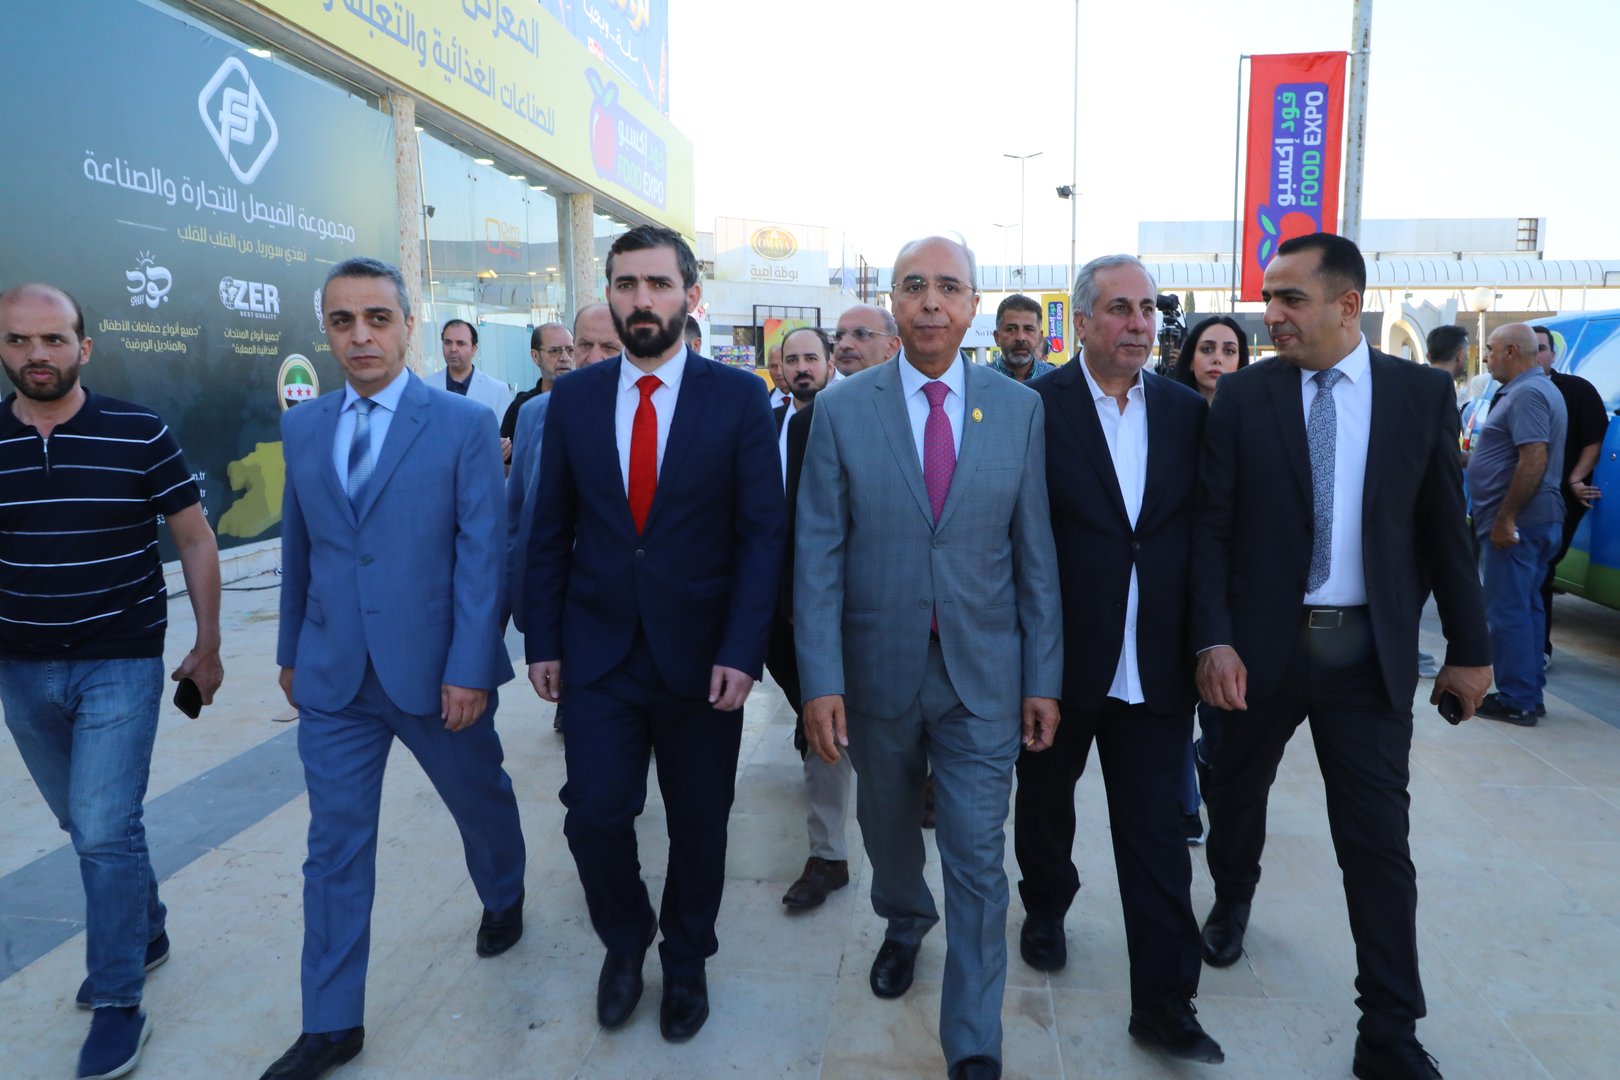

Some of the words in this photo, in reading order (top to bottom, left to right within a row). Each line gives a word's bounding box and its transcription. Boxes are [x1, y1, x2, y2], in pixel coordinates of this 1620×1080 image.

[341, 0, 427, 68] والتعب
[432, 28, 496, 100] الغذائية
[500, 82, 555, 136] للصناعات
[1277, 91, 1300, 132] فود
[1303, 91, 1324, 146] EXPO
[84, 150, 177, 206] والصناعة
[182, 176, 238, 216] للتجارة
[617, 154, 641, 191] FOOD
[643, 170, 664, 204] EXPO
[1300, 150, 1321, 207] FOOD
[242, 193, 295, 229] الفيصل
[298, 207, 356, 244] مجموعة
[177, 224, 207, 244] للقلب
[209, 230, 237, 249] القلب
[238, 235, 253, 255] من
[131, 320, 161, 334] حفاضات
[240, 310, 254, 318] BEST
[254, 312, 277, 320] QUALITY
[154, 338, 187, 354] والمناديل
